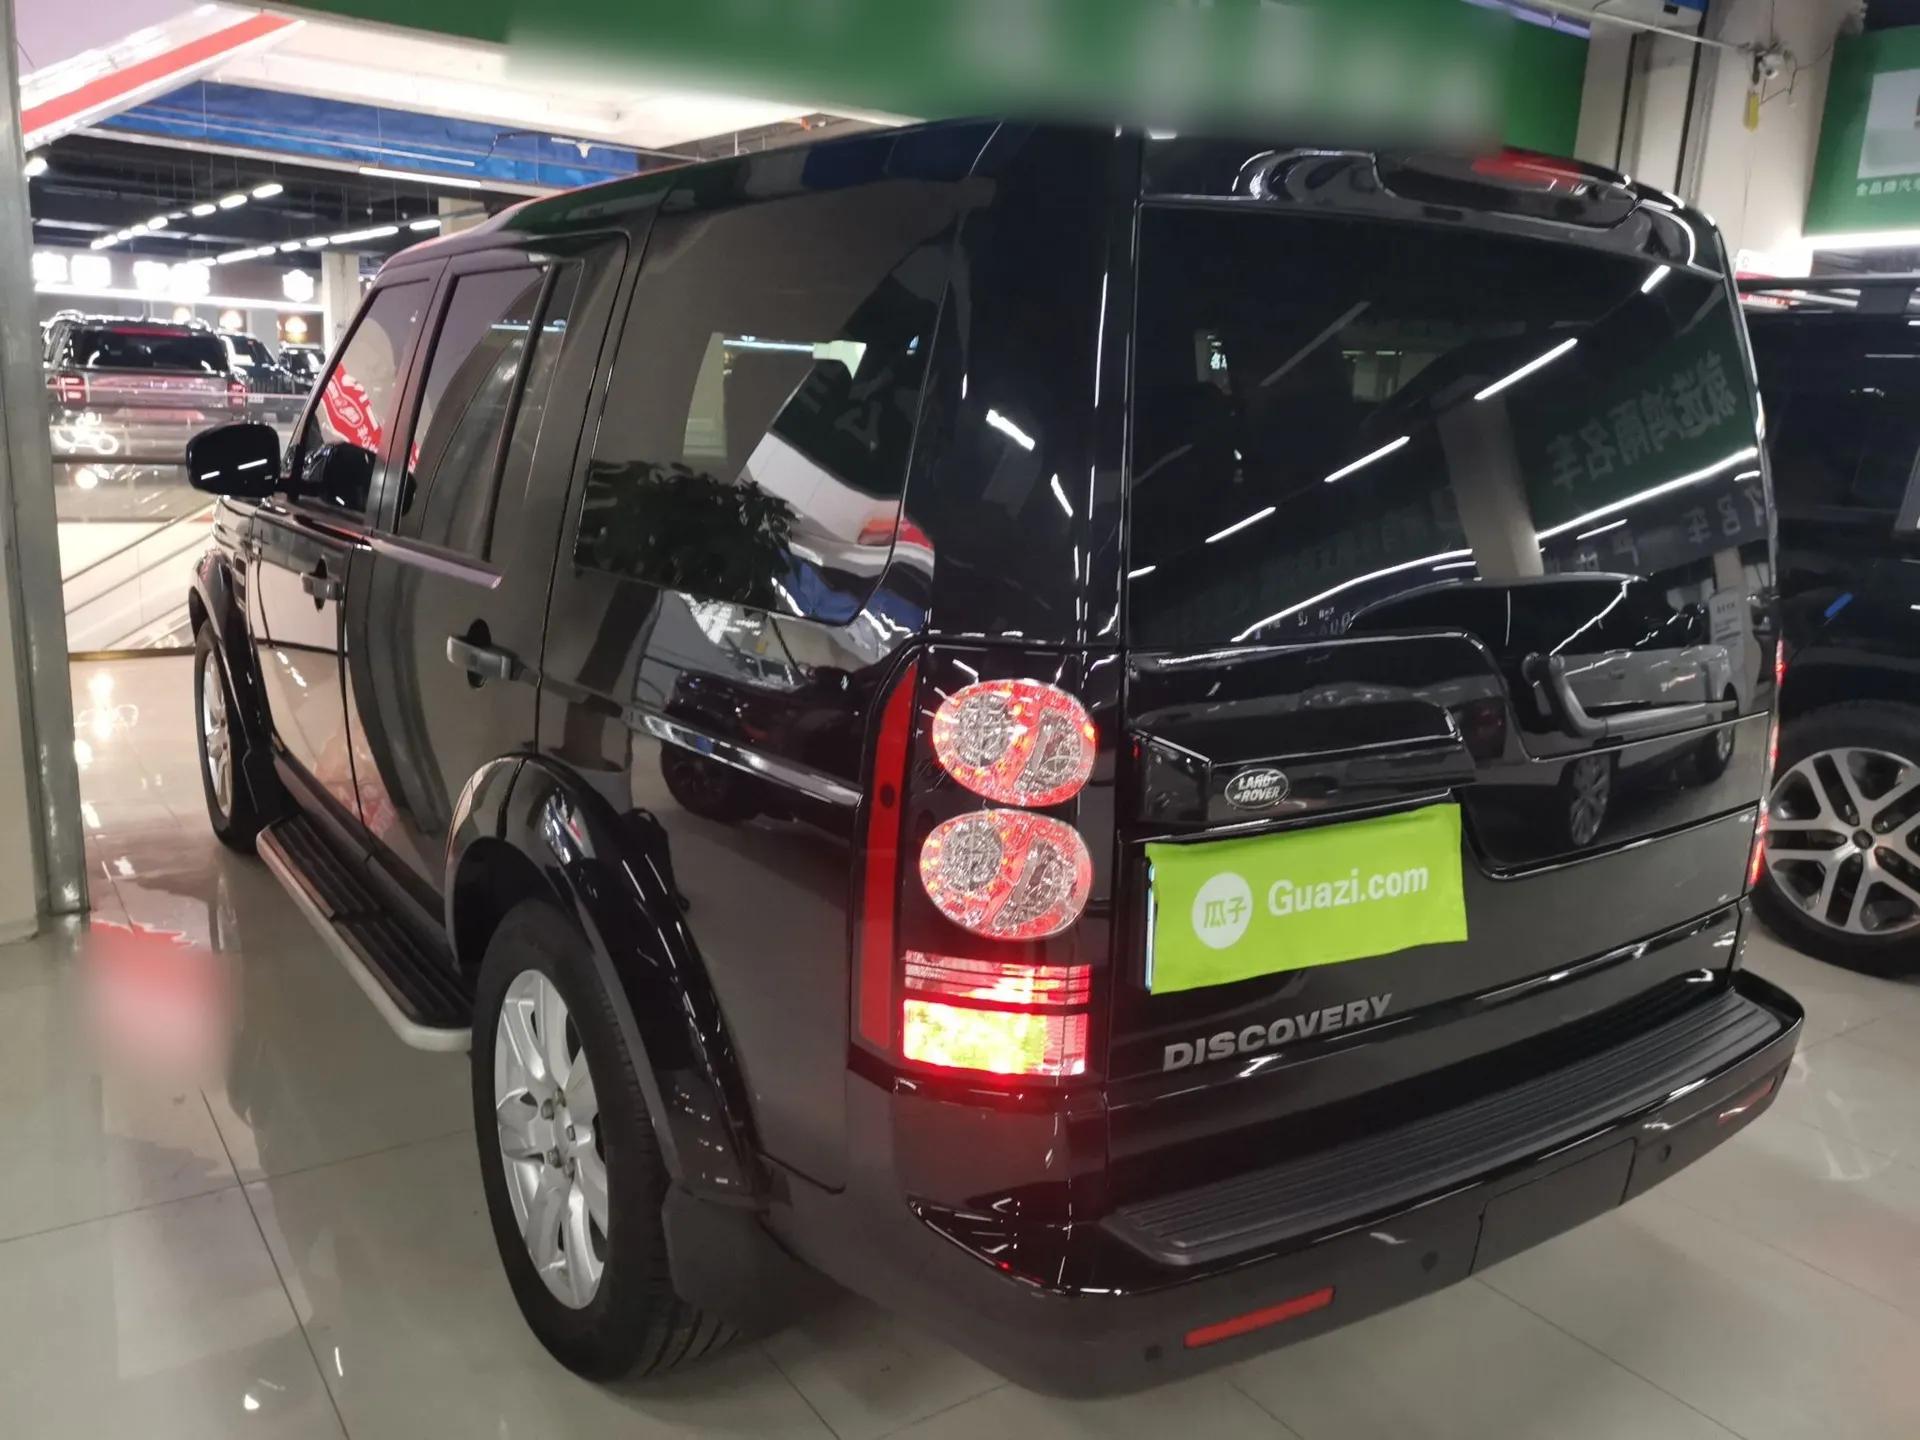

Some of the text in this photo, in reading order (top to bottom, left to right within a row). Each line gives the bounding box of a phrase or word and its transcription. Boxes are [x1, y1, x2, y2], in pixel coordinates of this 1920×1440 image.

[1238, 773, 1271, 791] LAND
[1240, 785, 1281, 802] ROVER
[1267, 866, 1430, 917] Guazi.com
[1203, 896, 1248, 929] 瓜子
[1162, 993, 1392, 1071] DISCOVERY
